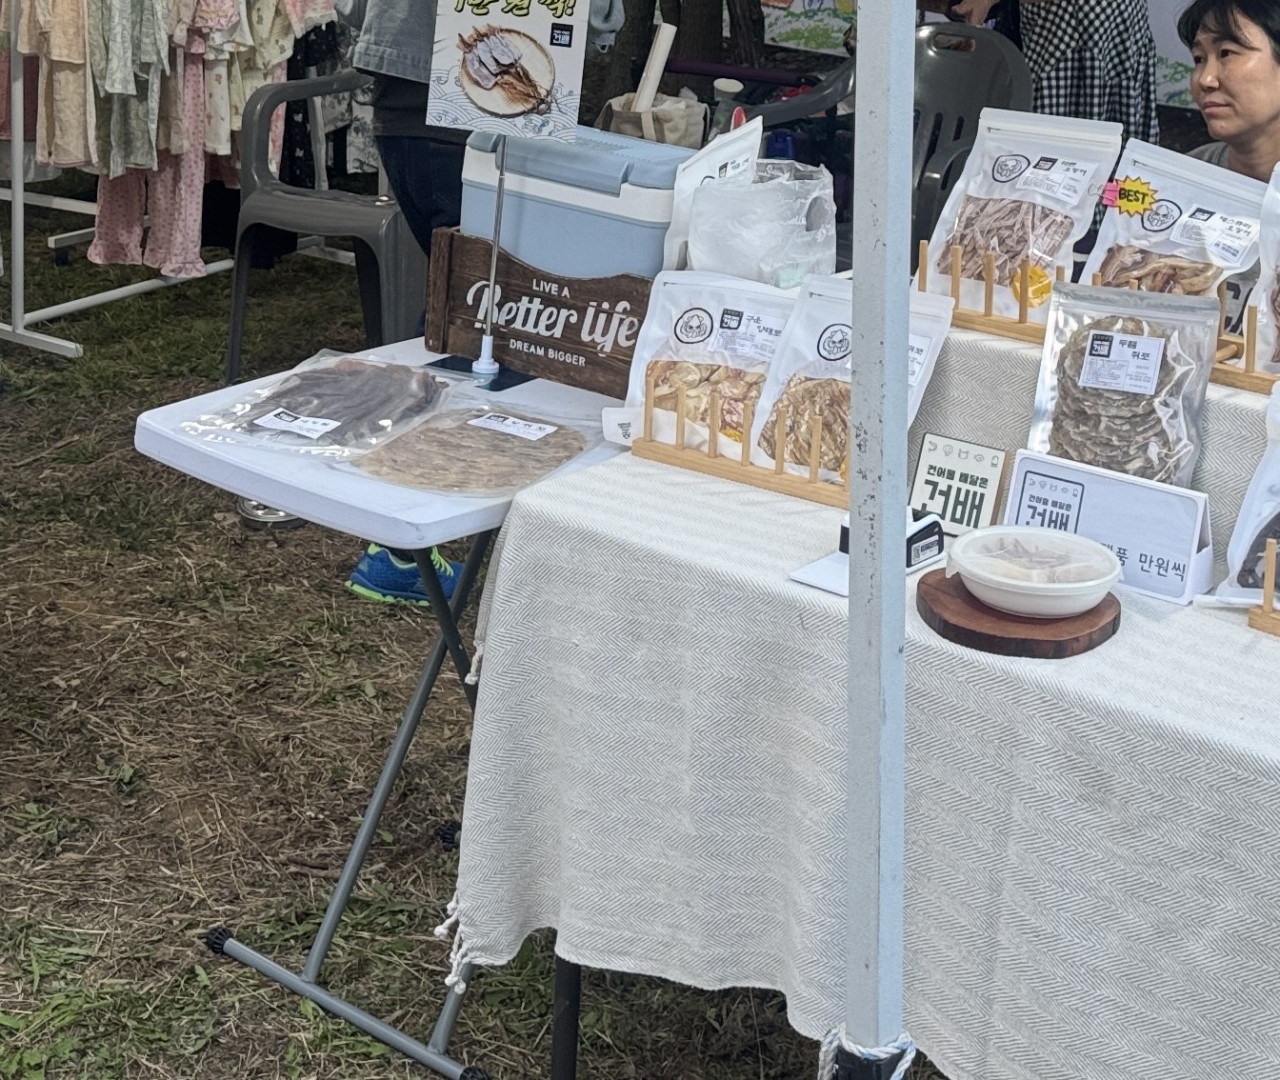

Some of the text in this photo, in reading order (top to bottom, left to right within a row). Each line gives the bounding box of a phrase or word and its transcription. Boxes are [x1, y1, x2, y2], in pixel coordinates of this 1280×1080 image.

[1119, 186, 1148, 205] BEST
[532, 279, 570, 298] LIVE A
[467, 280, 577, 339] Better
[510, 339, 586, 367] DREAM BIGGER
[927, 464, 989, 489] 건어물 배달은
[921, 479, 985, 528] 건배
[1139, 553, 1187, 582] 만원씩
